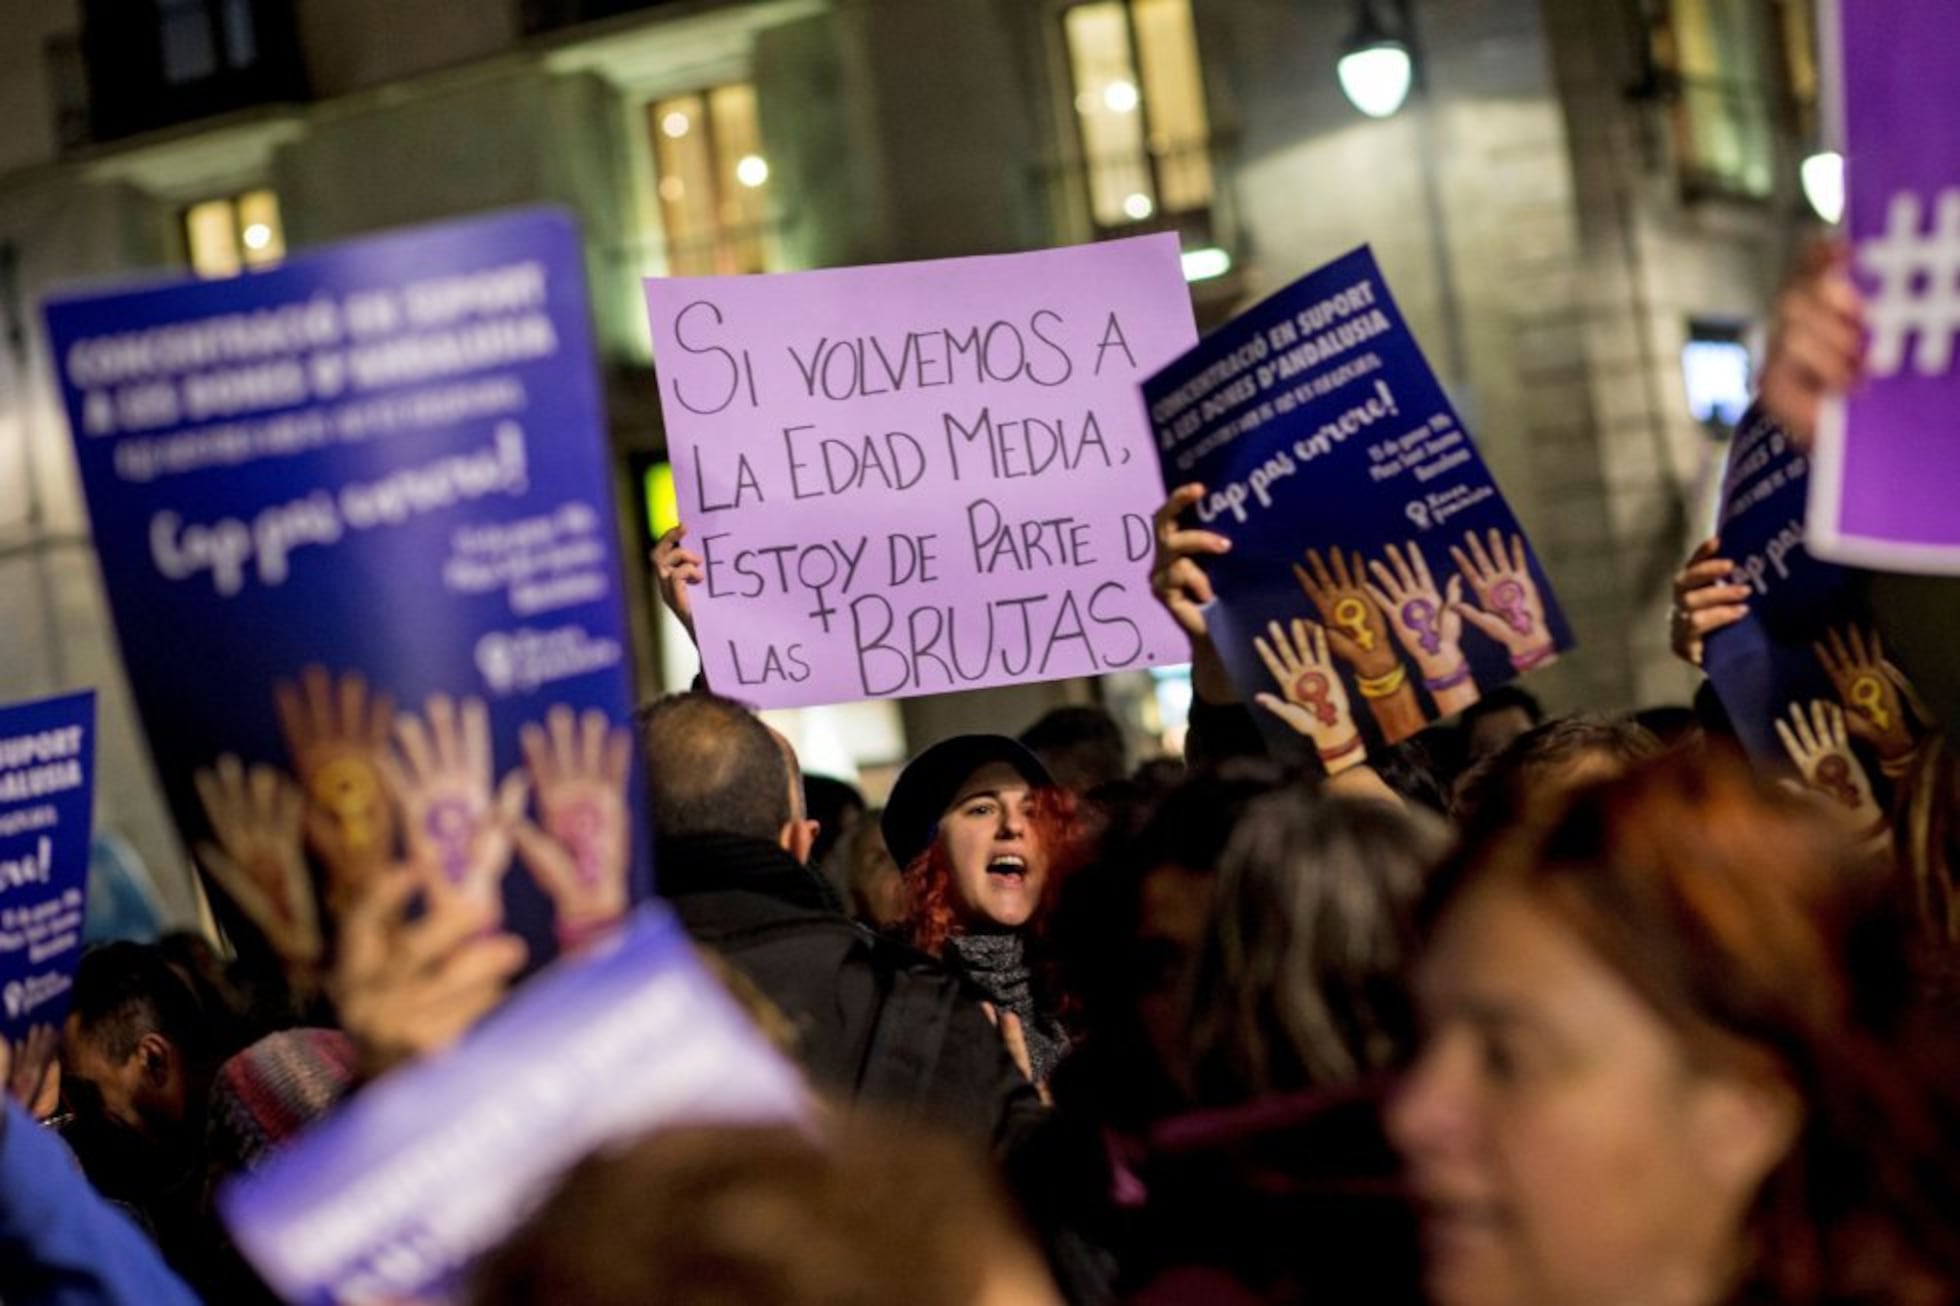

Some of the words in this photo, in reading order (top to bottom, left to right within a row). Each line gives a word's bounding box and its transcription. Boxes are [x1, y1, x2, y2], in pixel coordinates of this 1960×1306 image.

[788, 309, 1072, 400] VOLVEMOS
[1095, 312, 1137, 376] A
[1268, 320, 1298, 350] EN
[1298, 280, 1375, 336] SUPORT
[693, 445, 763, 513] LA
[783, 424, 926, 499] EDAD
[943, 408, 1131, 480] MEDIA,
[1249, 451, 1296, 507] pas
[1293, 379, 1398, 461] enrere!
[702, 533, 867, 633] ESTOY
[889, 533, 938, 587] DE
[967, 499, 1097, 573] PARTE
[1122, 513, 1152, 562] D
[729, 640, 811, 685] LAS
[851, 582, 1155, 696] BRUJAS.
